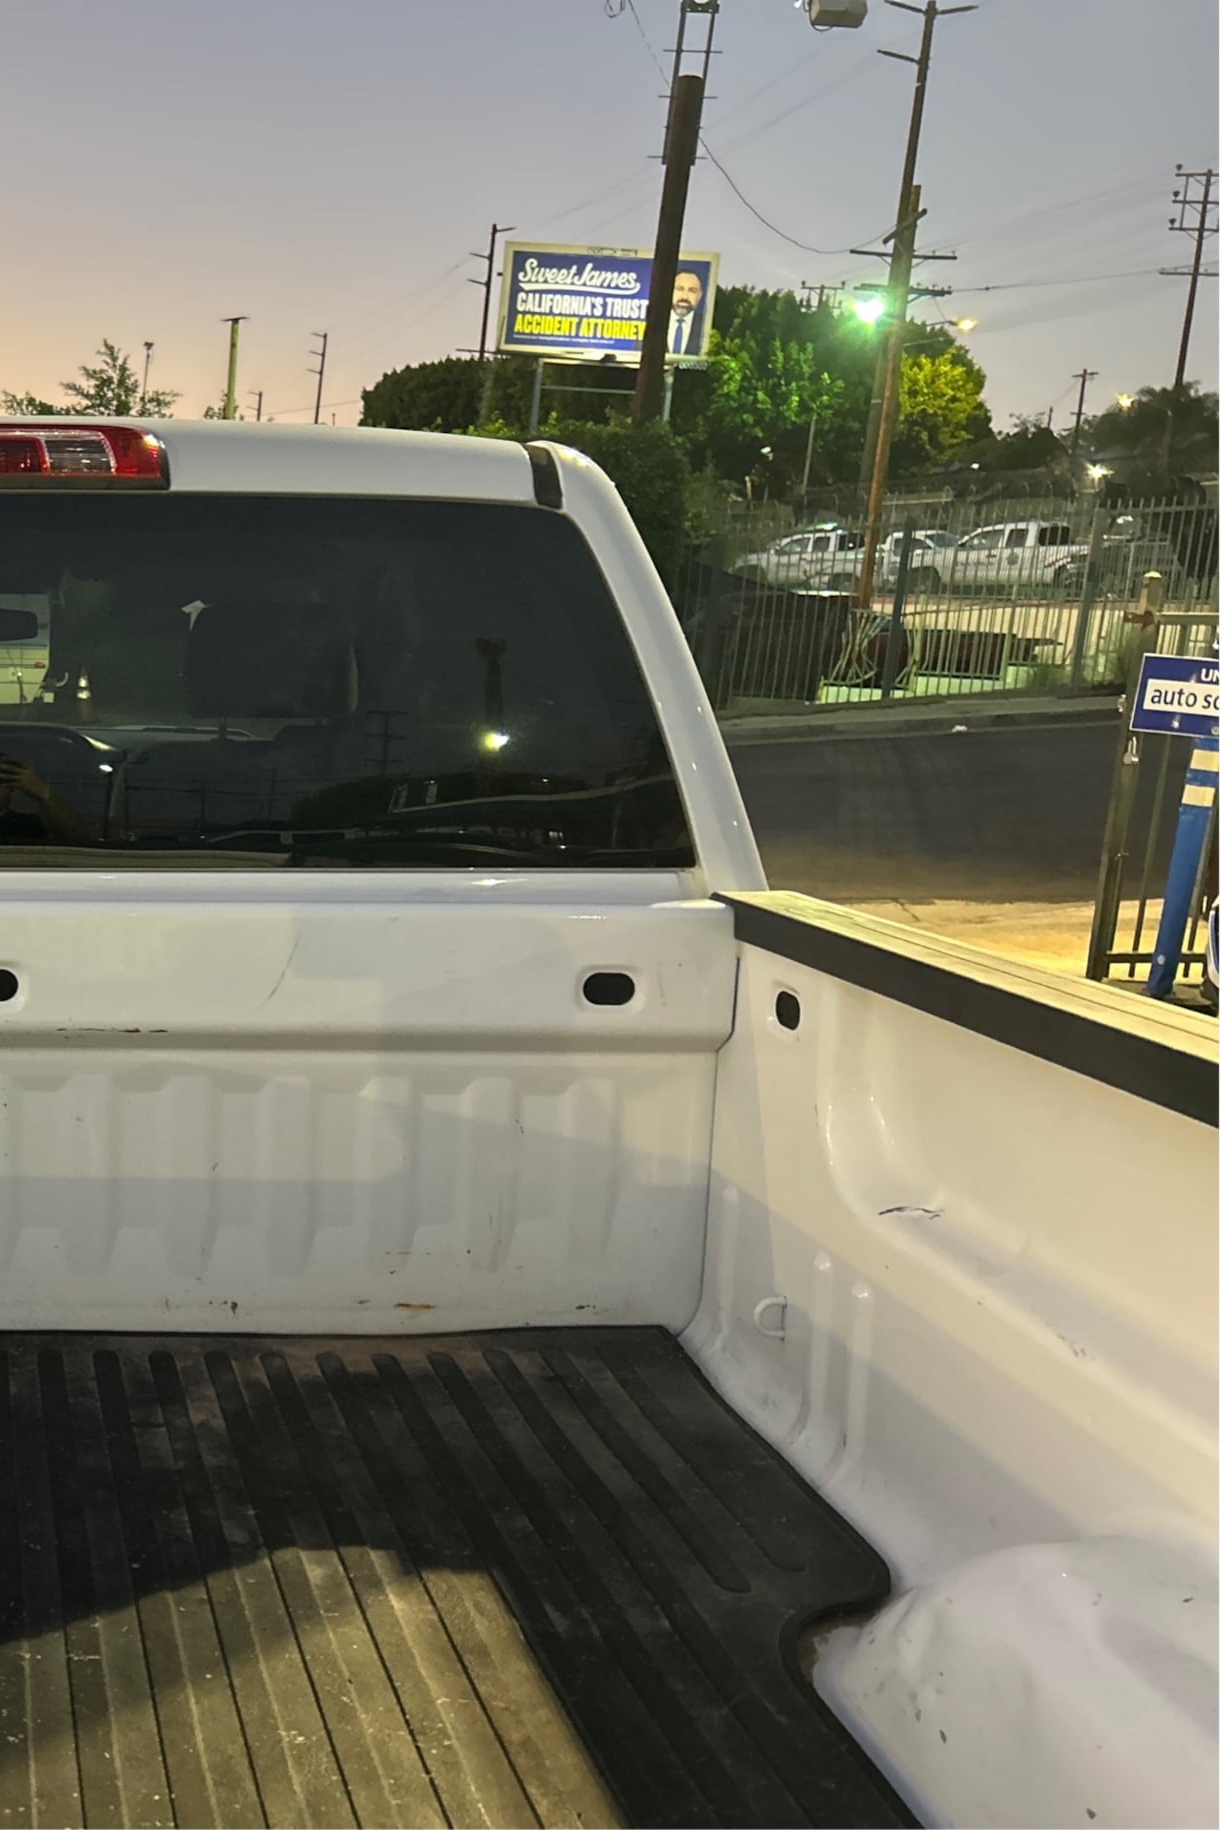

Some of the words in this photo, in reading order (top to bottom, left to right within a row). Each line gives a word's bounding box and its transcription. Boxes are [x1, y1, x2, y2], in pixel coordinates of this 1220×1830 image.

[518, 258, 577, 284] Sweet
[573, 263, 638, 289] James
[516, 292, 604, 317] CALIFORNIA'S
[514, 313, 579, 337] ACCIDENT
[1150, 688, 1198, 708] auto
